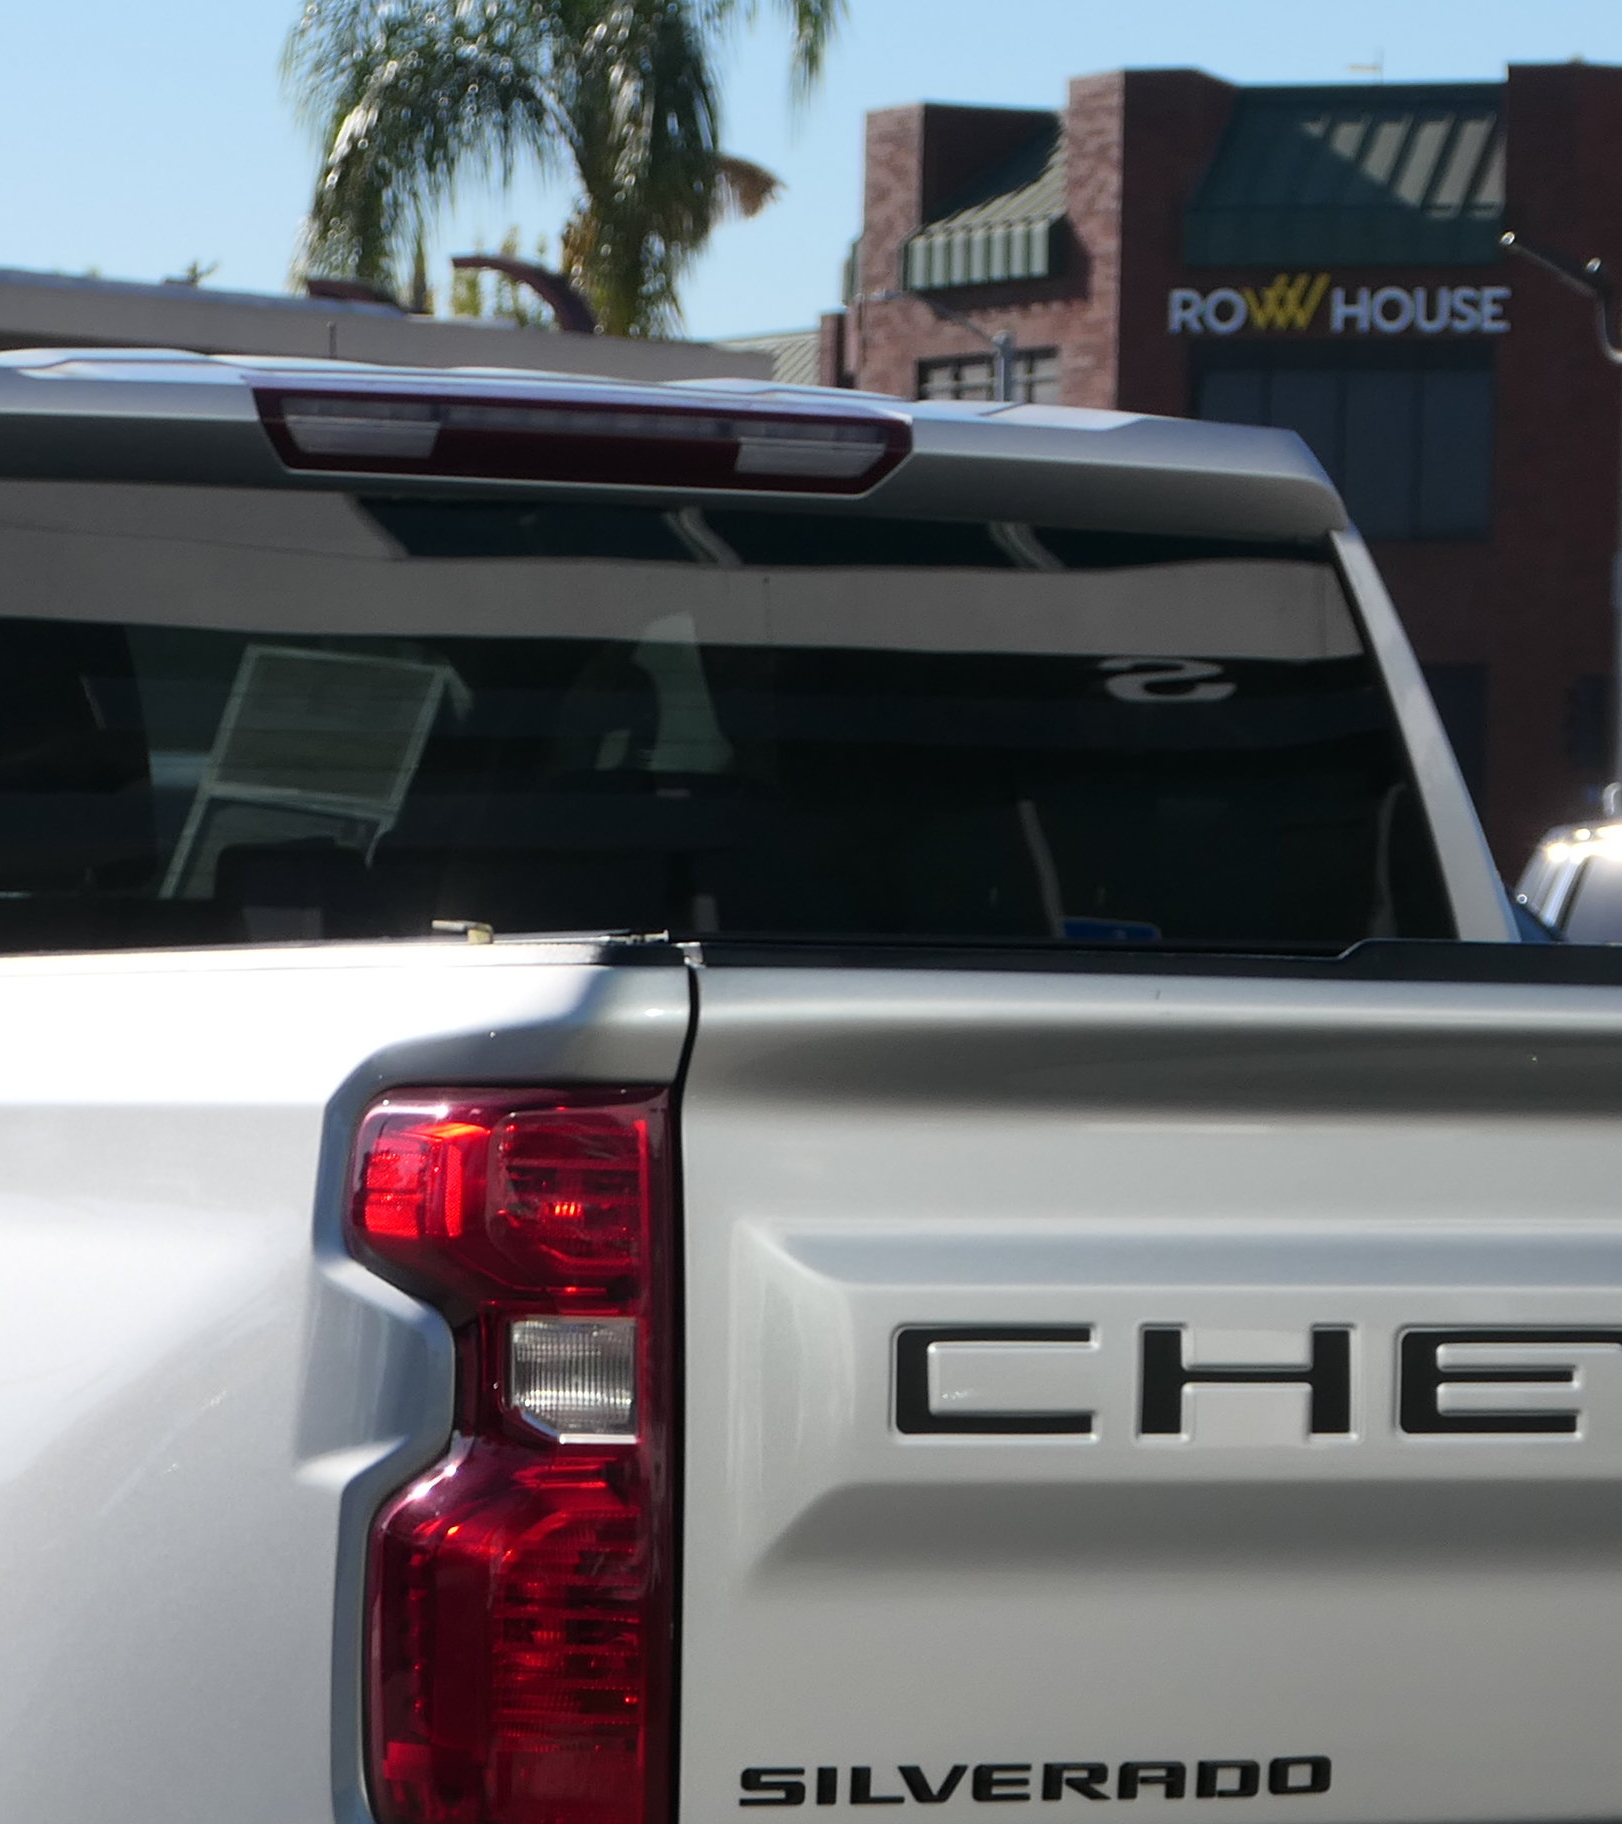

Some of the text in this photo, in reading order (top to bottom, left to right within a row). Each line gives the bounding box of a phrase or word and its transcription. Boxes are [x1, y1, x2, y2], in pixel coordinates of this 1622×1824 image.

[1166, 271, 1513, 336] ROW HOUSE
[738, 1755, 1332, 1808] SILVERADO
